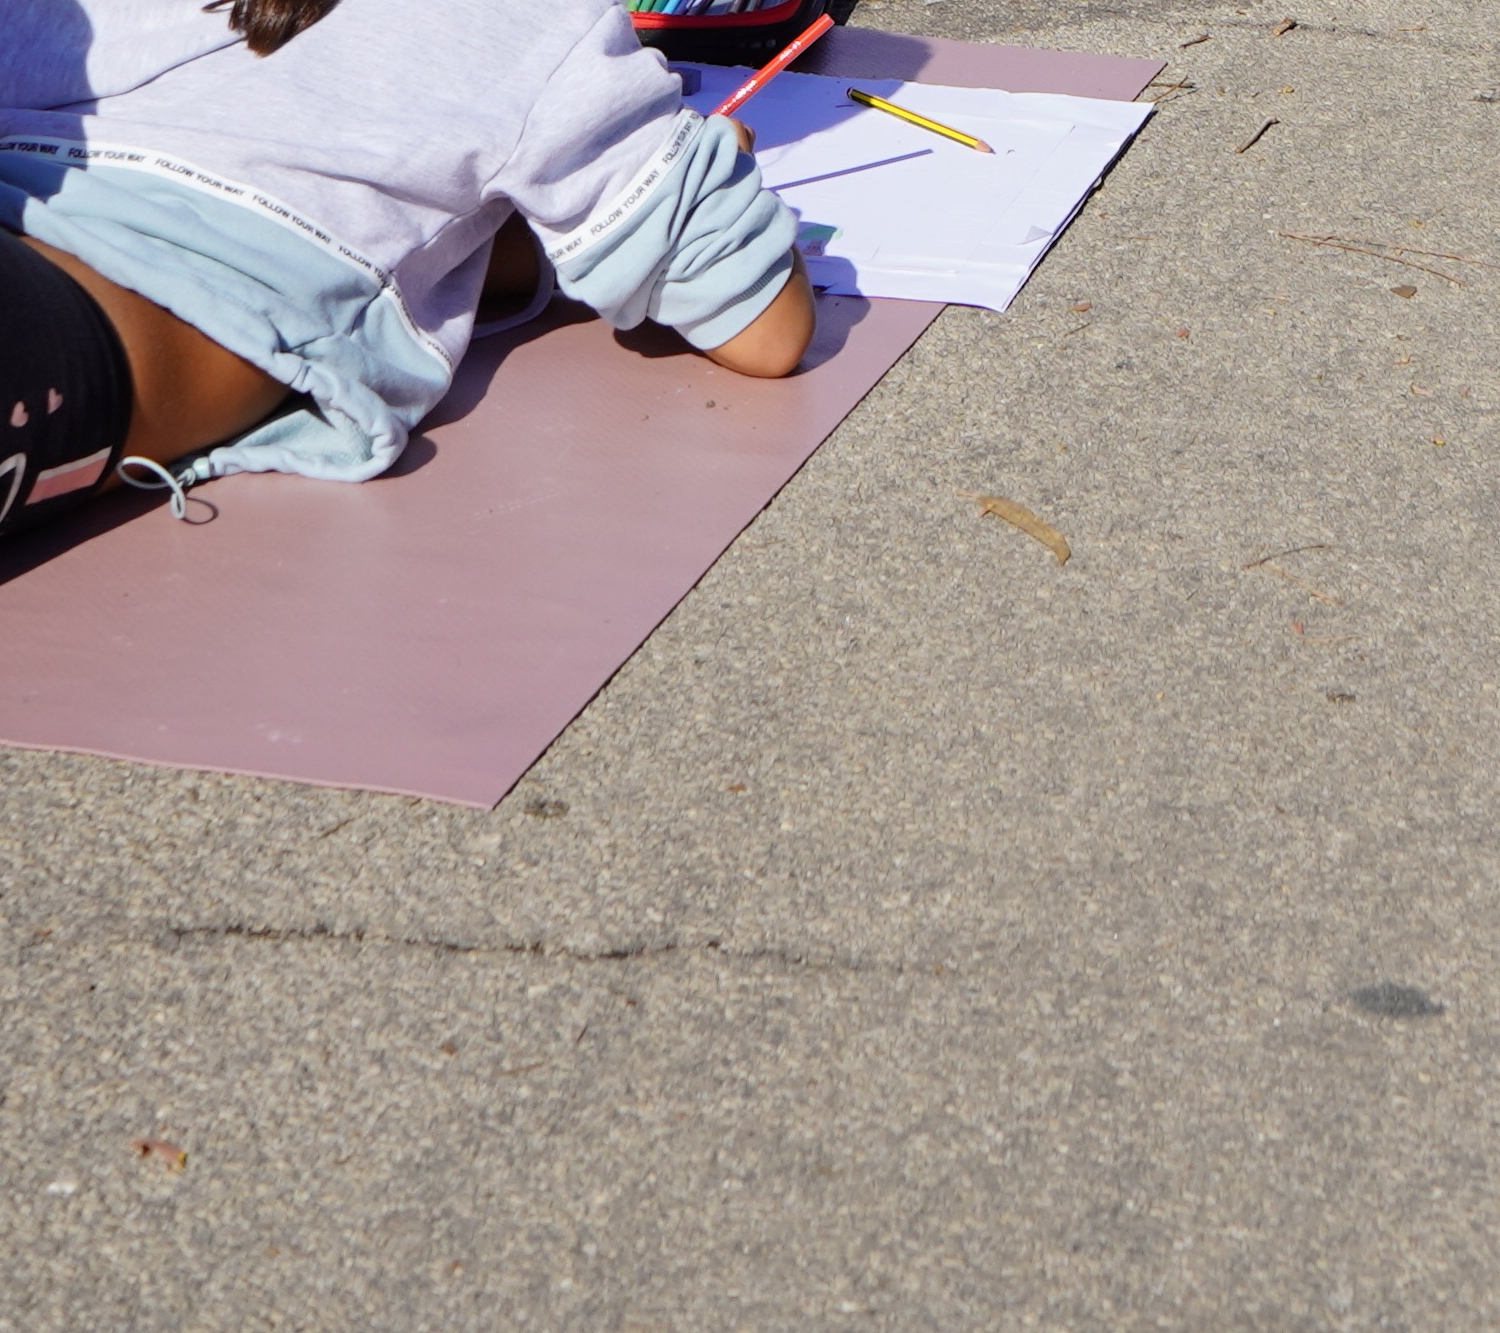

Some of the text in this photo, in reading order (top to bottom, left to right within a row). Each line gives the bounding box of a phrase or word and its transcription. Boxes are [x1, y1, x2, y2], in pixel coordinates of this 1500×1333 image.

[68, 148, 147, 163] FOLLOW YOUR WAY
[154, 158, 245, 198] FOLLOW YOUR WAY
[590, 168, 662, 237] FOLLOW YOUR WAY
[252, 194, 332, 246] FOLLOW YOUR WAY
[338, 245, 373, 271] FOLLOW
[548, 237, 583, 261] OUR WAY
